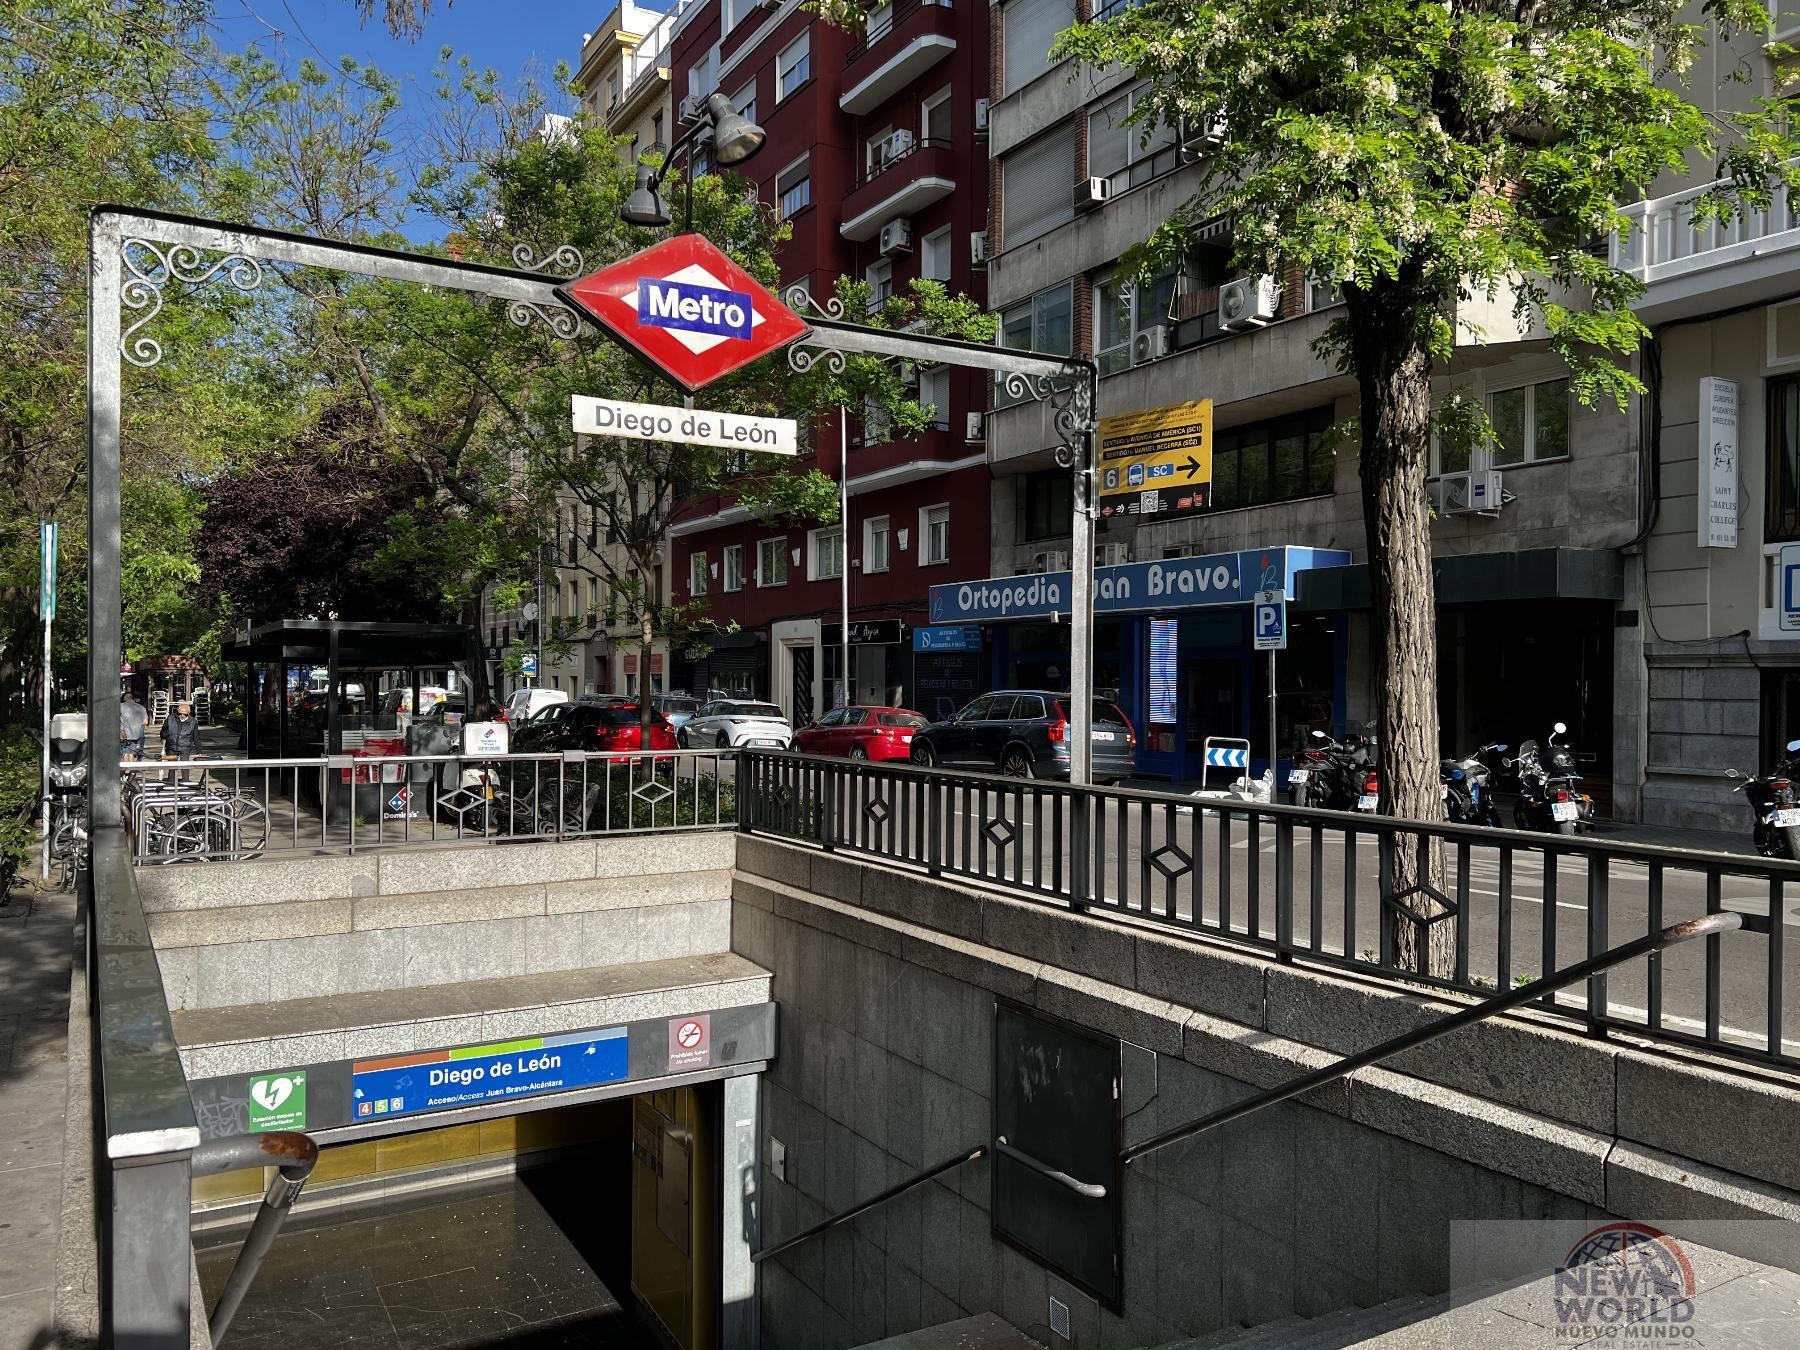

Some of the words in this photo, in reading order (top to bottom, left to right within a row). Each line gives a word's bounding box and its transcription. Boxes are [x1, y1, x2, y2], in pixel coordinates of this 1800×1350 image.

[649, 285, 745, 328] Metro
[595, 405, 672, 436] Diego
[680, 415, 711, 438] de
[719, 419, 777, 445] León
[1106, 469, 1116, 488] 6
[1153, 465, 1168, 476] SC
[1714, 486, 1731, 496] SAINT
[1711, 500, 1737, 511] CHARLES
[1710, 515, 1737, 525] COLLEGE
[957, 577, 1060, 615] Ortopedia
[1148, 564, 1241, 597] Bravo.
[1259, 606, 1277, 635] P
[670, 1051, 694, 1060] Prohibido
[683, 1056, 703, 1064] smoking
[429, 1066, 485, 1086] Diego
[489, 1061, 513, 1077] de
[518, 1053, 561, 1074] León
[427, 1092, 485, 1106] Acceso/Access
[485, 1089, 504, 1097] Juan
[505, 1079, 563, 1094] Bravo-Alcántara
[361, 1103, 369, 1114] 4
[377, 1101, 385, 1111] 5
[393, 1098, 401, 1110] 6
[252, 1114, 276, 1123] Estación
